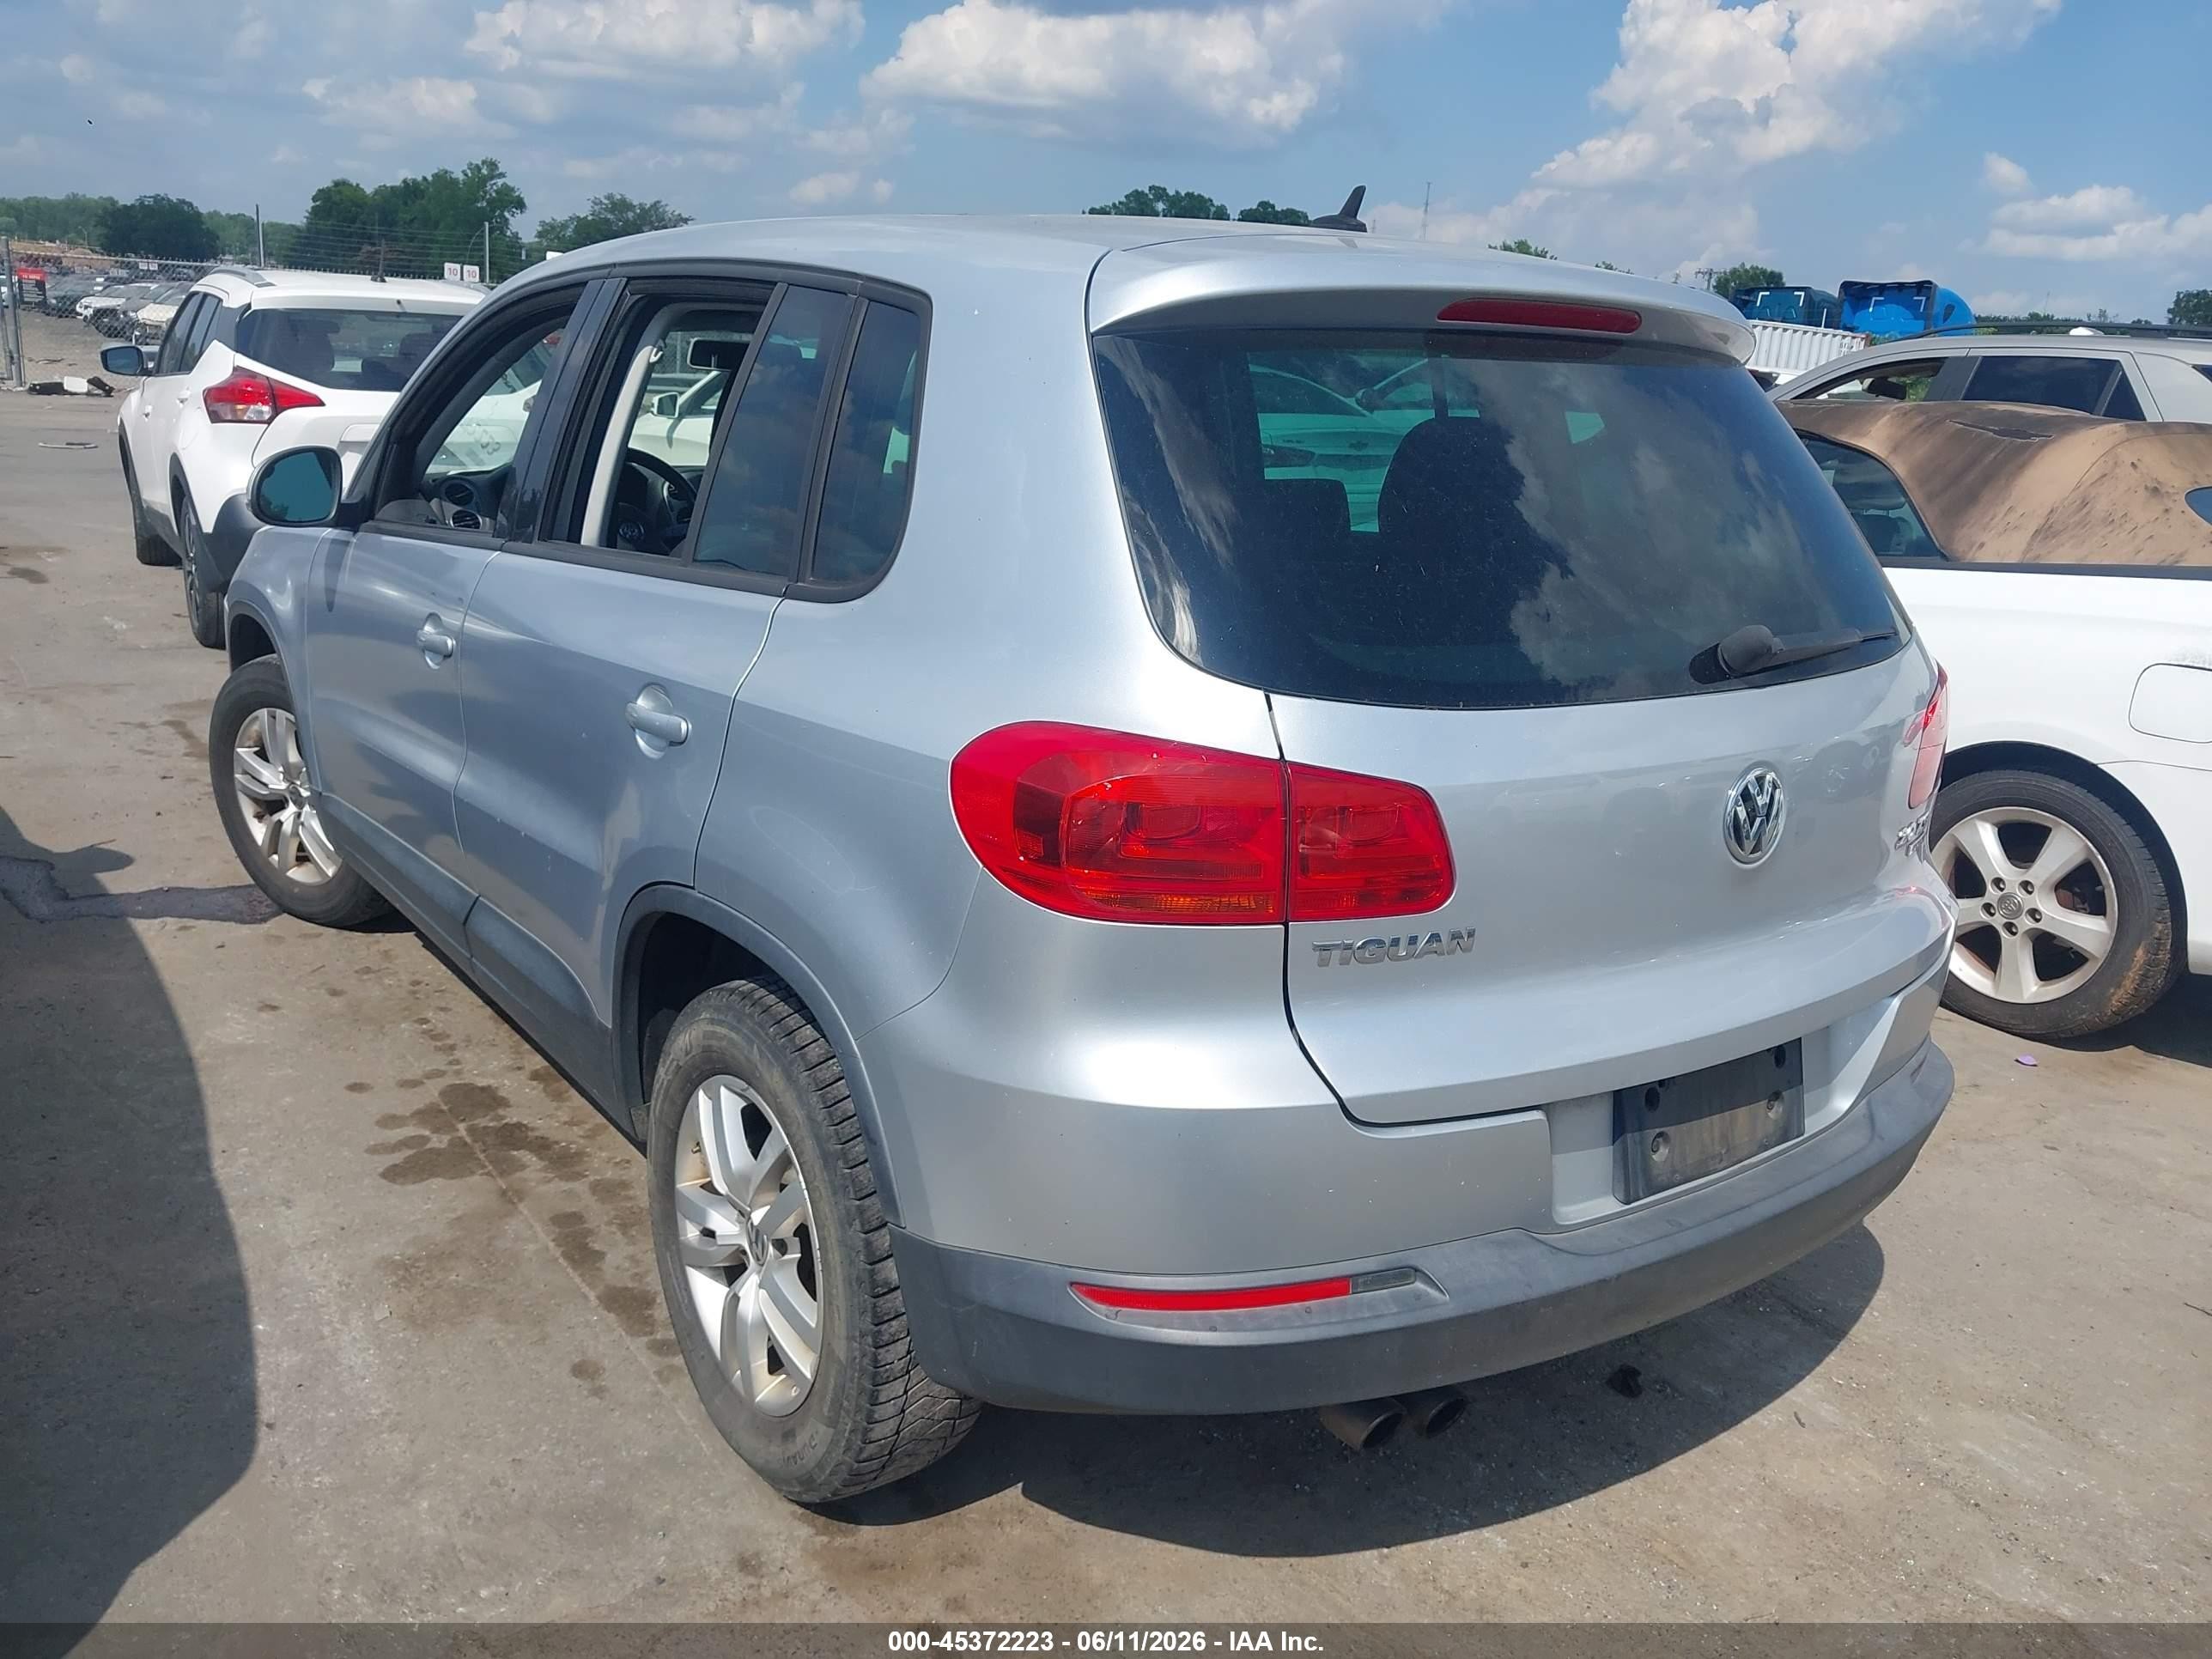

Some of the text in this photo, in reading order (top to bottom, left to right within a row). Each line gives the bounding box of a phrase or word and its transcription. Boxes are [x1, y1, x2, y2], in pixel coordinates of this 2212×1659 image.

[447, 267, 459, 276] 10
[466, 269, 477, 278] 10
[1312, 927, 1476, 967] TIGUAN
